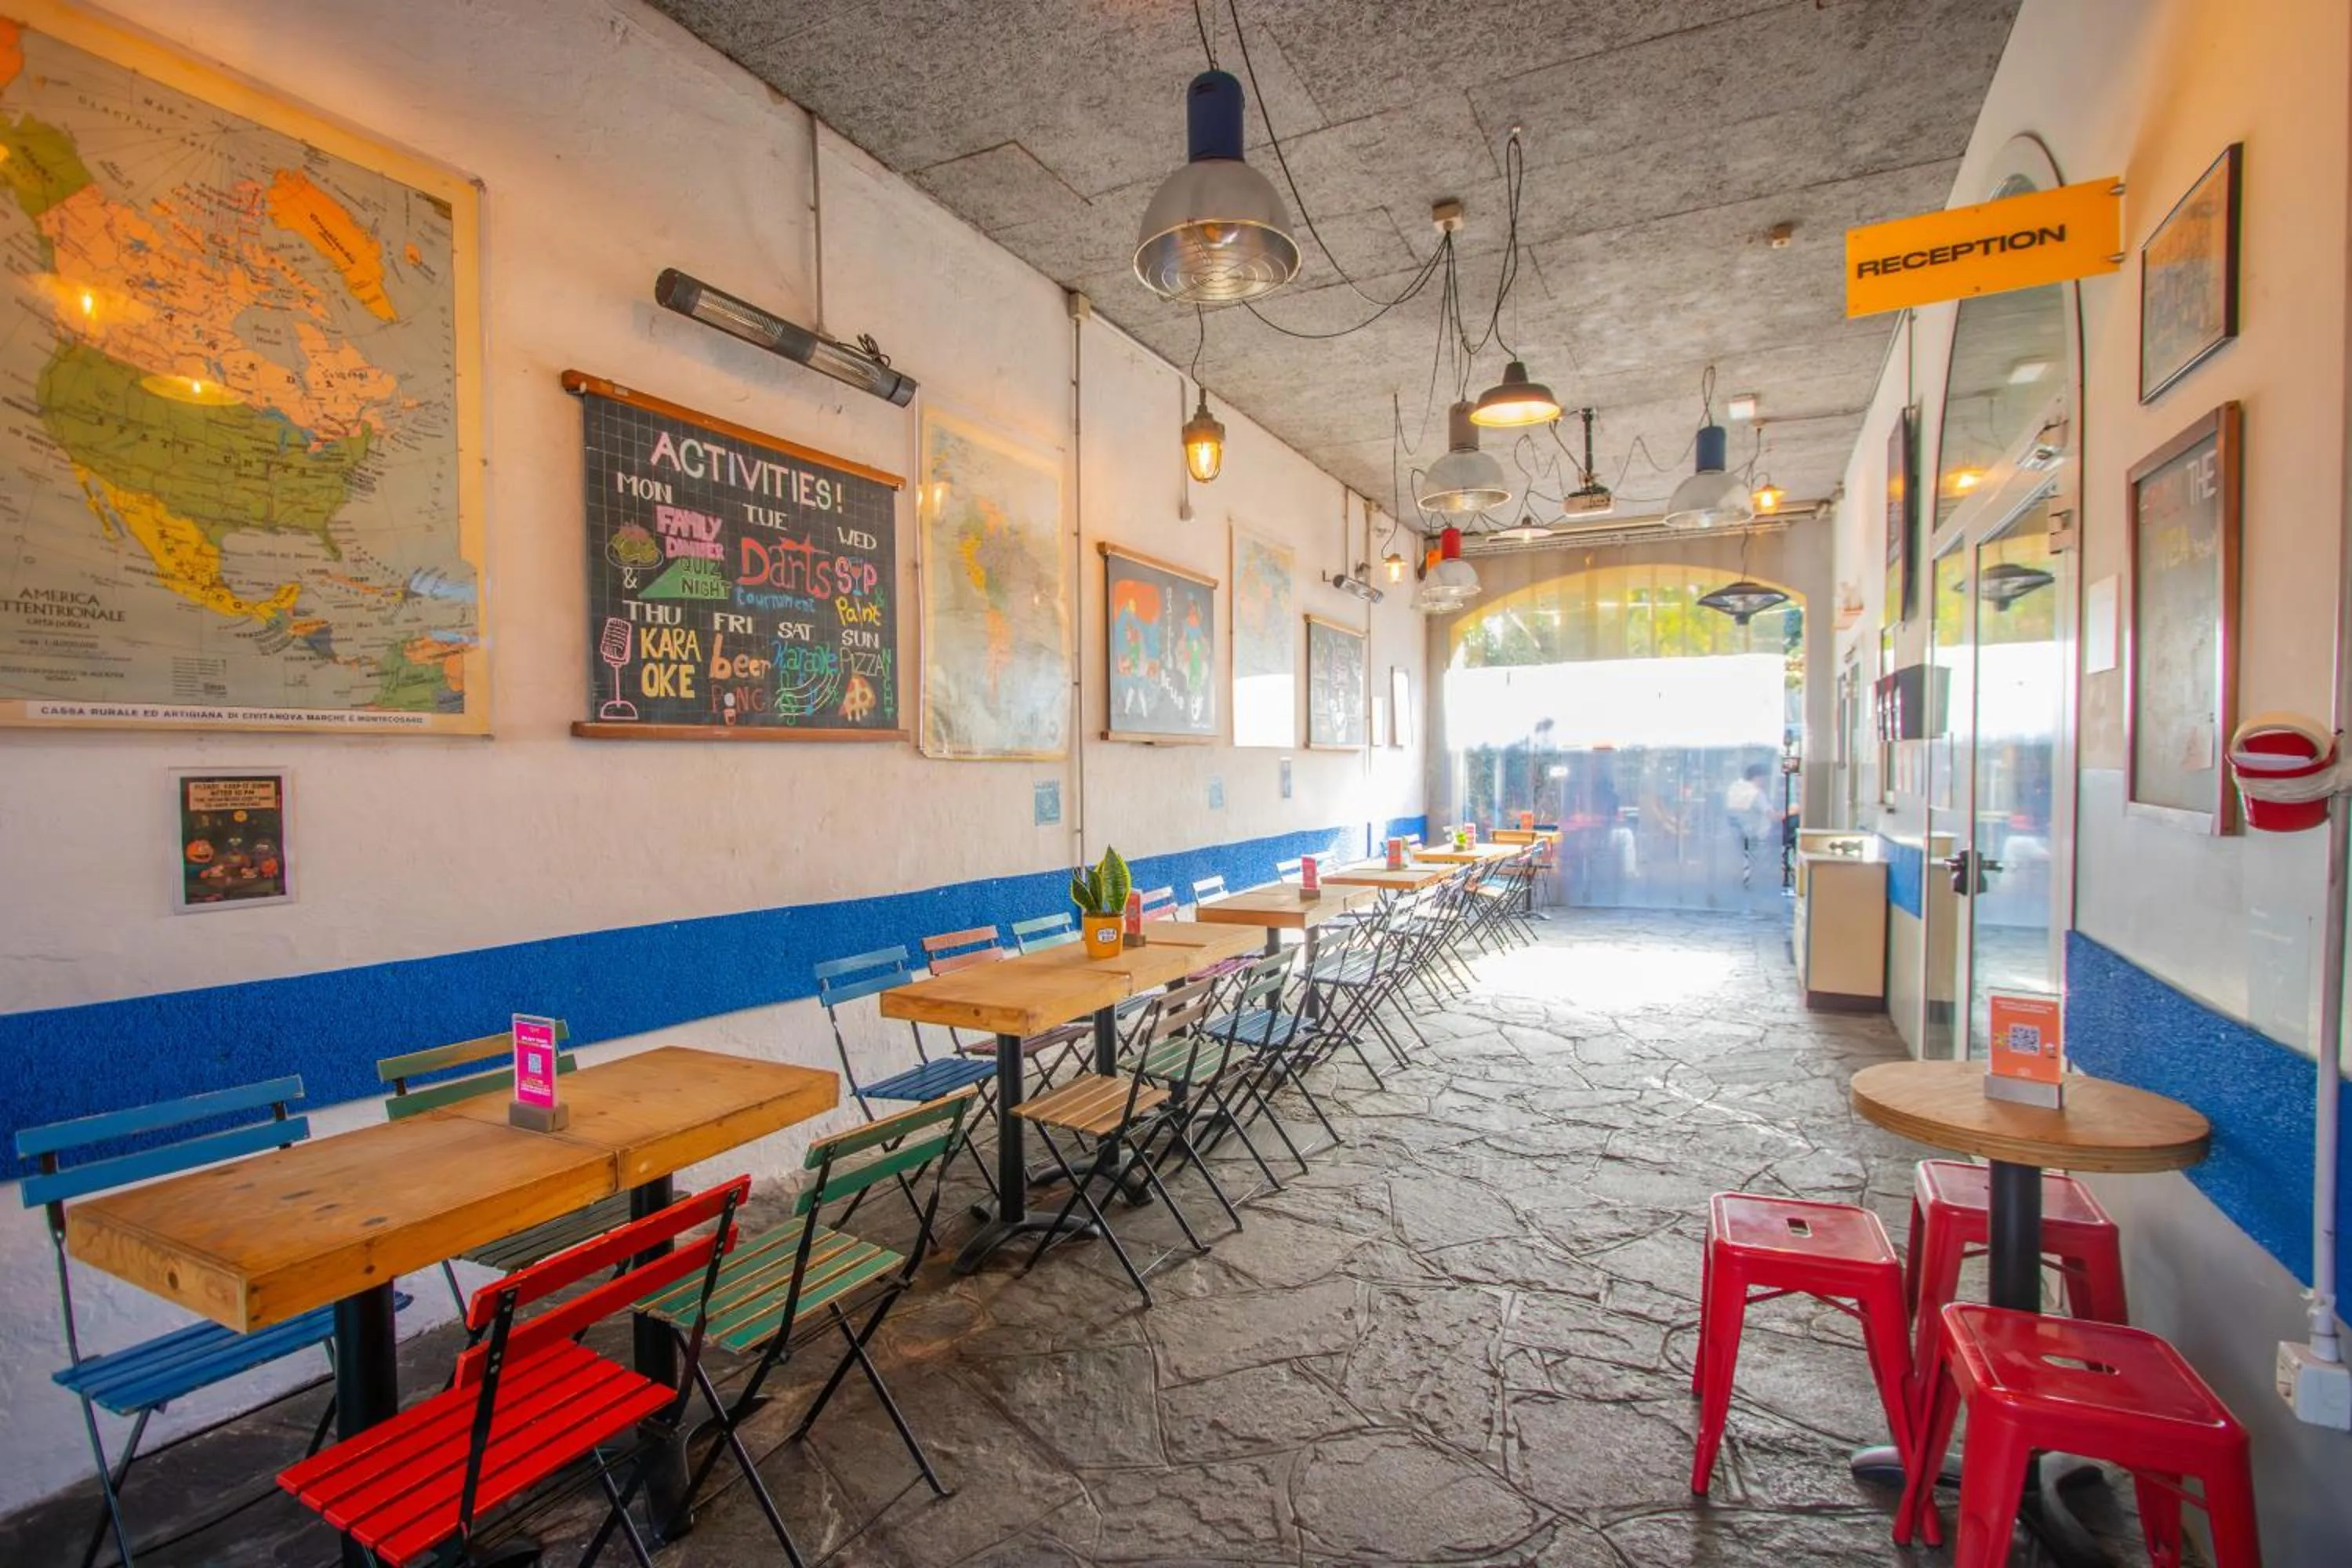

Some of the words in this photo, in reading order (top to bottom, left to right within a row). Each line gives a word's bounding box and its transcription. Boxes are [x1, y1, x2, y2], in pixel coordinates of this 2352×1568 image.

[1857, 223, 2067, 279] RECEPTION
[616, 472, 673, 506] MON
[2186, 448, 2218, 506] THE
[655, 504, 723, 542] FAMILY
[742, 503, 789, 531] TUE
[837, 526, 877, 550] WED
[622, 567, 638, 589] &
[681, 557, 722, 576] QUIZ
[735, 535, 832, 599] Darts
[20, 587, 100, 607] AMERICA
[681, 577, 731, 597] NIGHT
[0, 600, 126, 622] TTENTRIONALE
[622, 600, 682, 625] THU
[713, 612, 753, 634] FRI
[640, 628, 702, 662] KARA
[778, 621, 815, 641] SAT
[841, 630, 880, 649] SUN
[709, 633, 771, 680] beer
[840, 647, 884, 677] PIZZA
[641, 662, 696, 699] OKE
[41, 706, 86, 717] CASSA
[90, 707, 137, 717] RURALE
[163, 710, 224, 719] ARTIGIANA
[241, 712, 303, 721] CIVITANOVA
